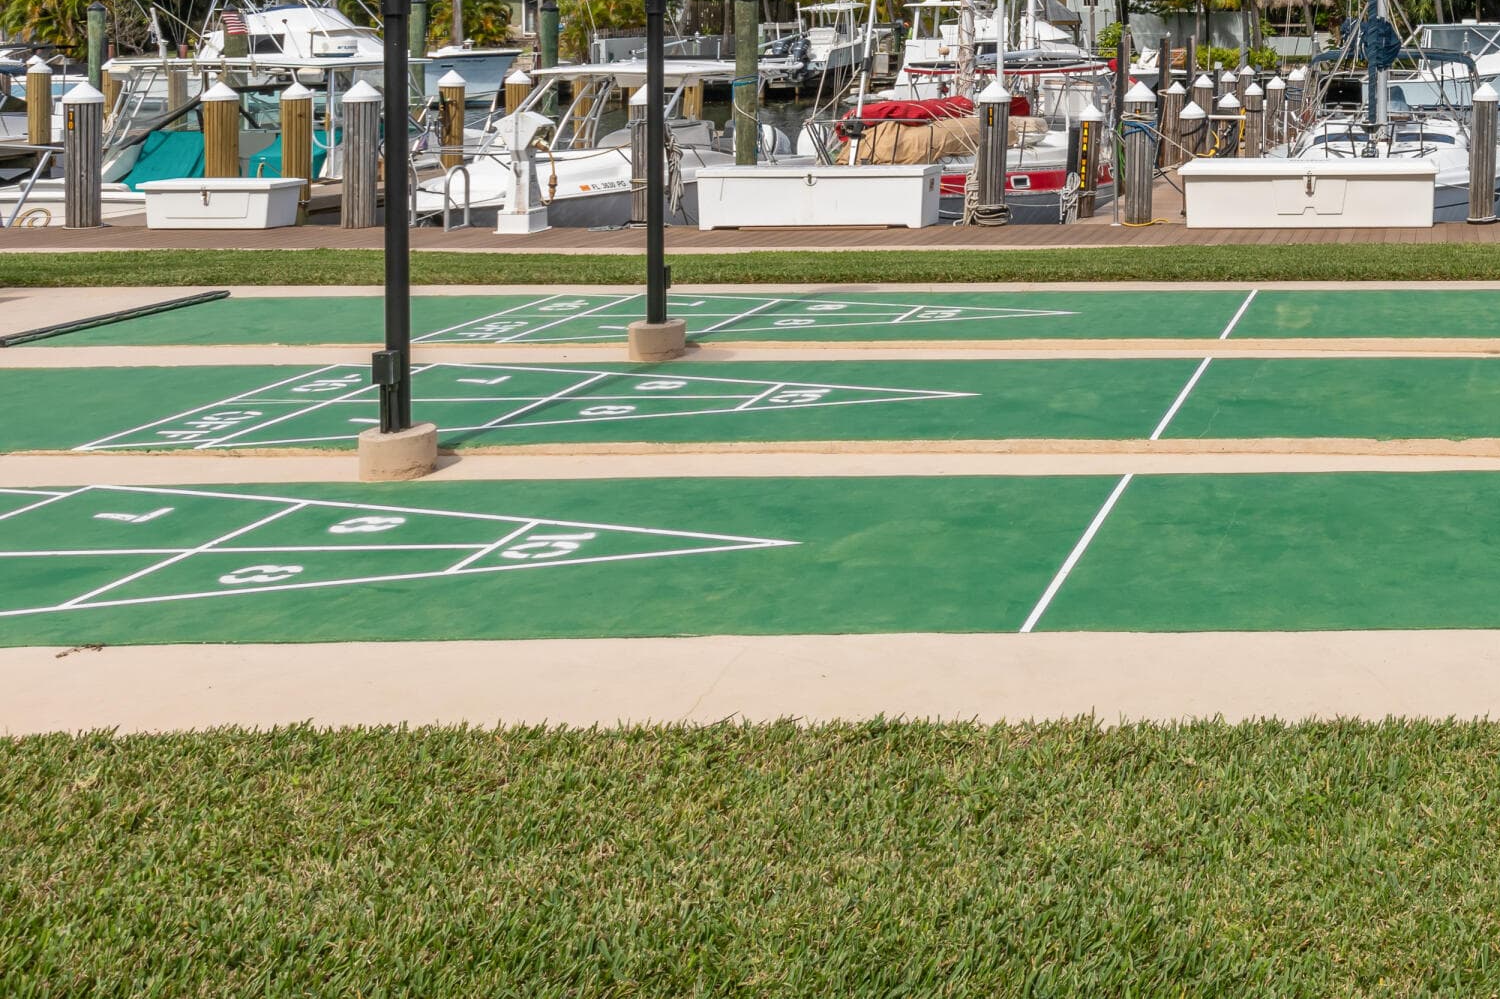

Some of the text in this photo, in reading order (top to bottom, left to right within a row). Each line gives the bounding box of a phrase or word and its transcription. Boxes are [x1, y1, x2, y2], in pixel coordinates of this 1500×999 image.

[987, 106, 993, 126] 11
[156, 410, 263, 440] OFF
[93, 507, 176, 523] 7
[328, 515, 407, 534] 8
[500, 532, 597, 559] 10
[218, 564, 304, 585] 8
